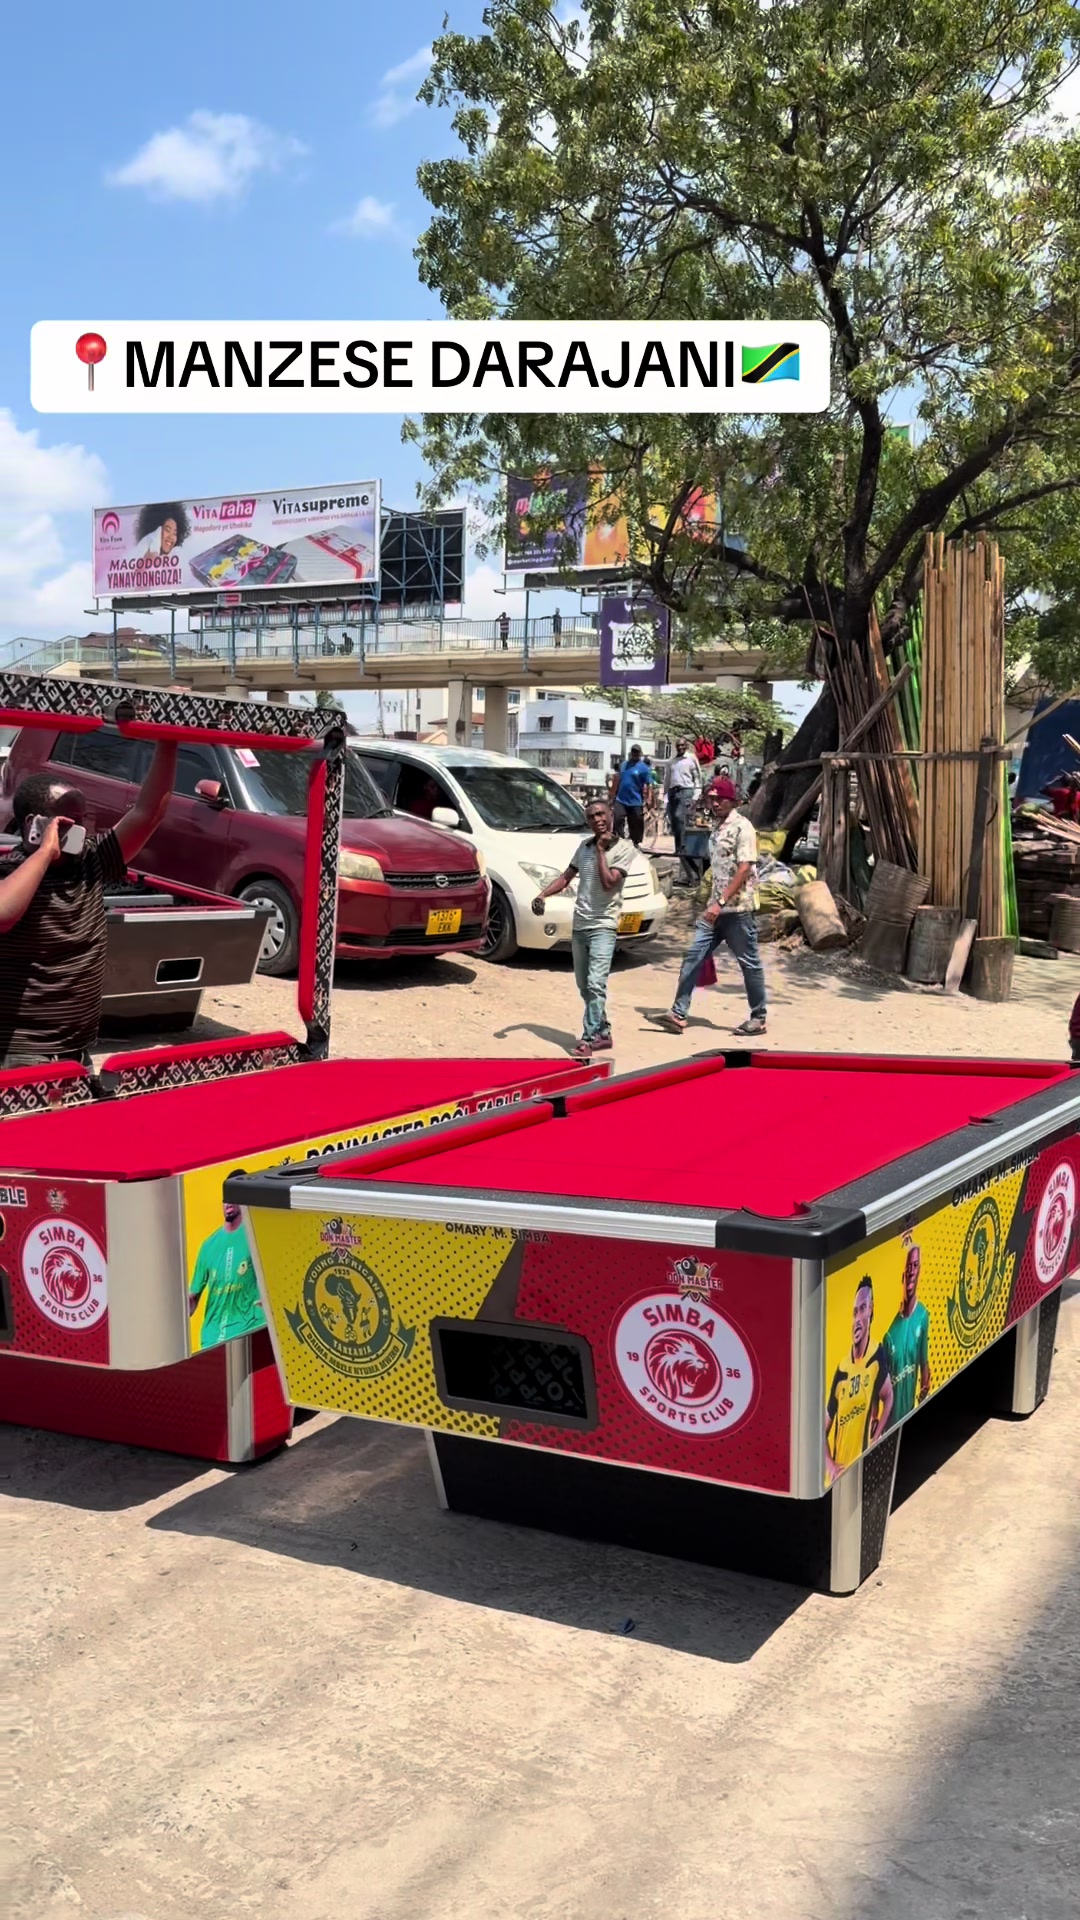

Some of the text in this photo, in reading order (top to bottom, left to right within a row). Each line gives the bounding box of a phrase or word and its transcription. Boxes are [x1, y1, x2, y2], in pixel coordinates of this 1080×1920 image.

[221, 500, 253, 518] raha
[109, 555, 180, 571] MAGODORO
[107, 568, 182, 589] YANAYOONGOZA!
[39, 1226, 86, 1252] SIMBA
[445, 1222, 487, 1237] OMARY
[510, 1228, 550, 1243] SIMBA
[30, 1266, 39, 1276] 19
[93, 1273, 103, 1283] 36
[308, 1257, 385, 1299] YOUNG AFRICANS
[667, 1271, 685, 1284] DON
[687, 1274, 723, 1290] MASTER
[39, 1294, 100, 1322] SPORTS CLUB
[642, 1303, 716, 1339] SIMBA
[306, 1332, 329, 1360] DAIMA
[333, 1339, 373, 1357] TANZANIA
[626, 1351, 640, 1362] 19
[725, 1367, 742, 1380] 36
[639, 1386, 735, 1425] SPORTS CLUB
